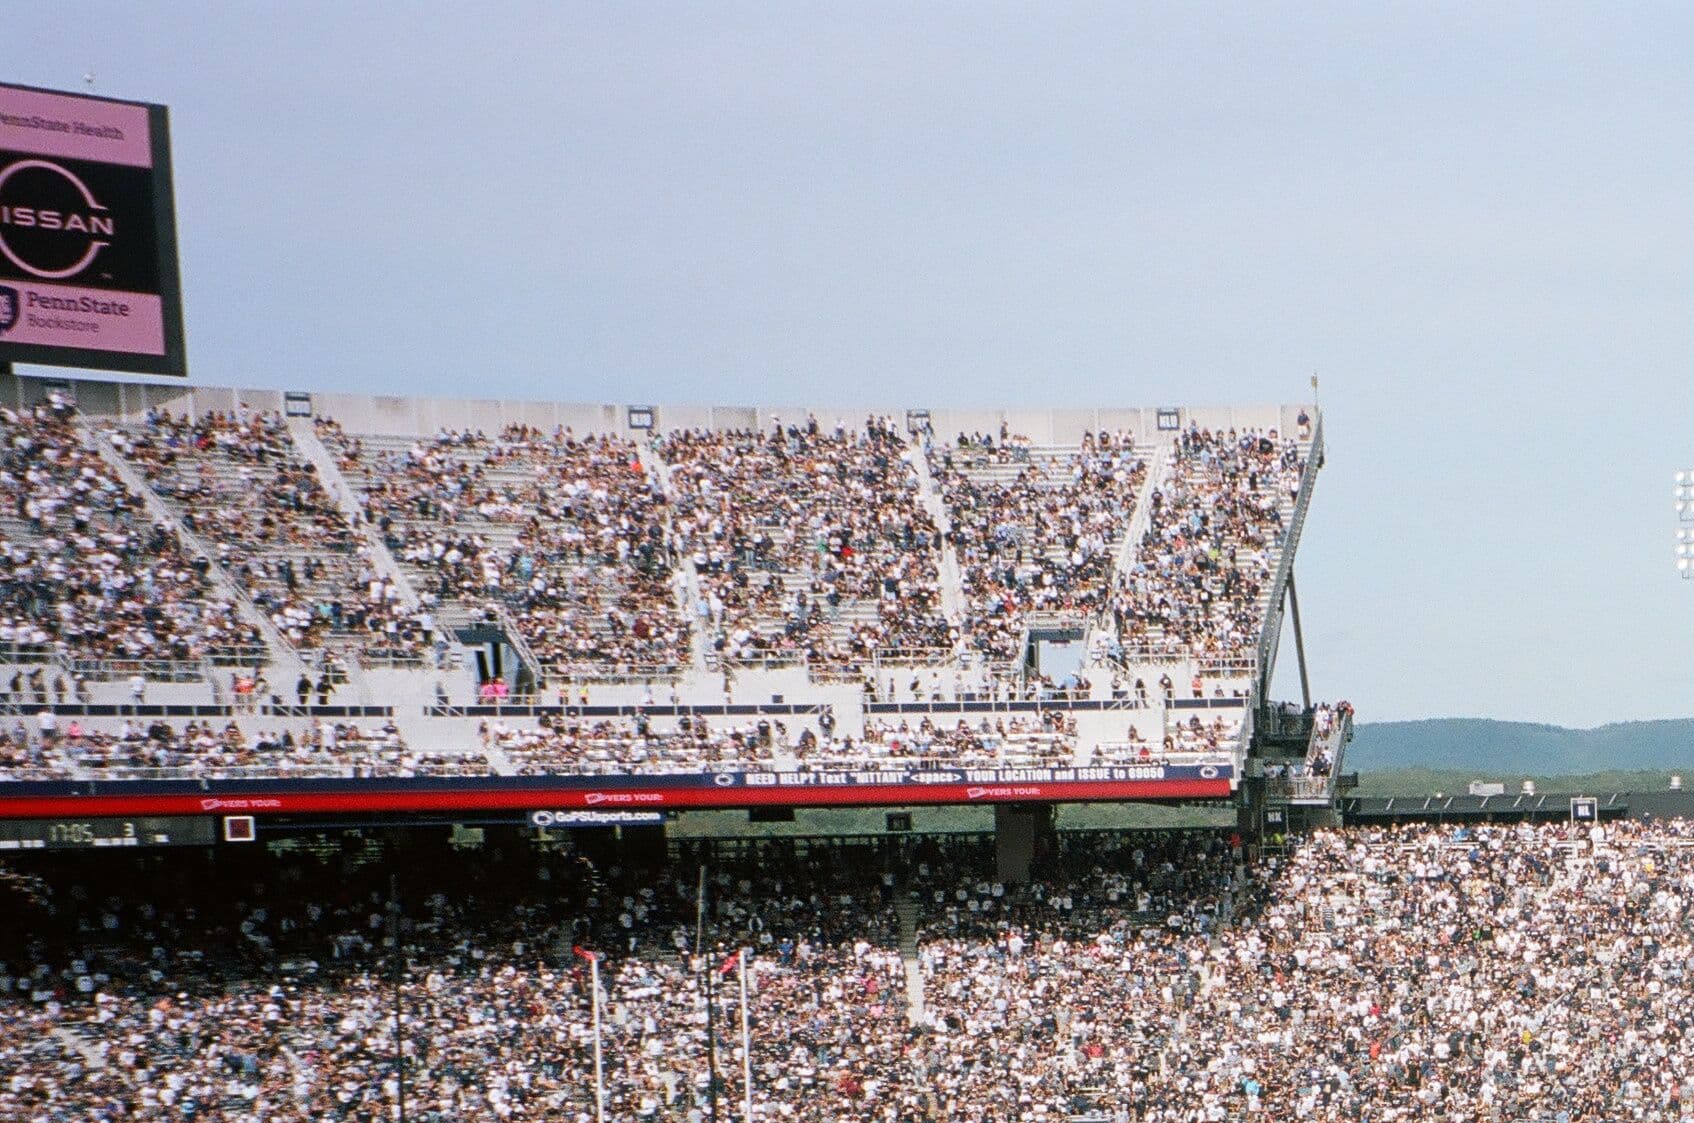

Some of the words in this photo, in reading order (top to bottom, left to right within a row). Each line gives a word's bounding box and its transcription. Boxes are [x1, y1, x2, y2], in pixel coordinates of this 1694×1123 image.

[0, 112, 70, 133] ennState
[73, 121, 124, 141] Health
[0, 205, 115, 236] ISSAN
[25, 291, 130, 317] PennState
[26, 313, 100, 333] Bookstore
[745, 773, 776, 785] NEED
[781, 772, 816, 785] HELP?
[820, 773, 847, 784] Text
[911, 772, 963, 785] <space>
[966, 769, 996, 782] YOUR
[999, 767, 1051, 781] LOCATION
[1054, 767, 1075, 780] and
[1078, 766, 1110, 780] ISSUE
[1114, 767, 1126, 779] to
